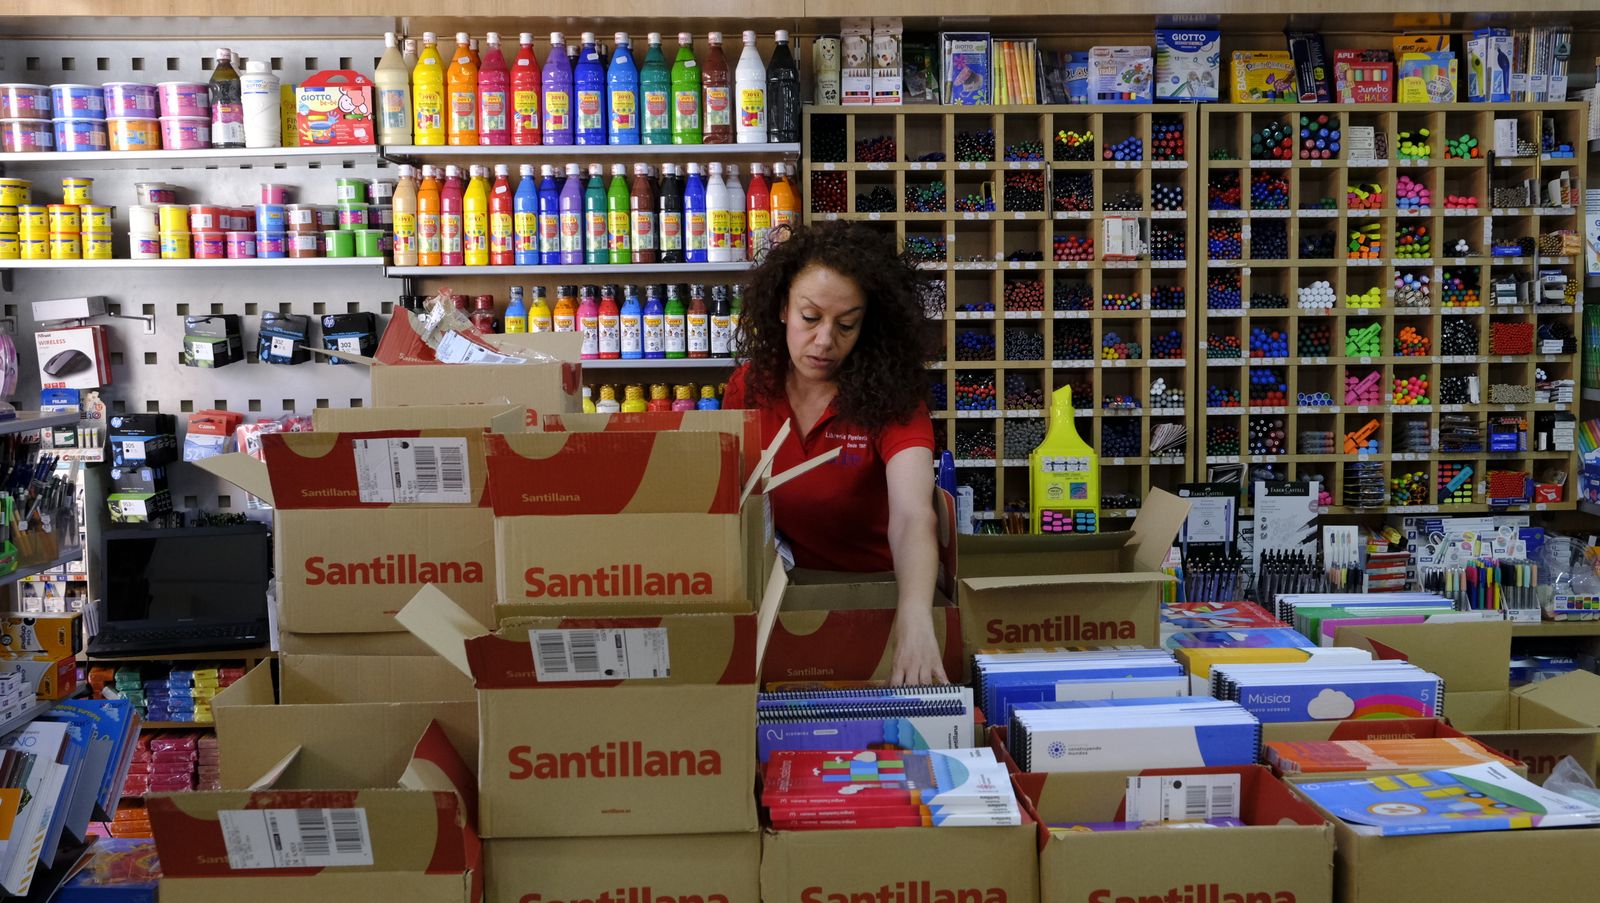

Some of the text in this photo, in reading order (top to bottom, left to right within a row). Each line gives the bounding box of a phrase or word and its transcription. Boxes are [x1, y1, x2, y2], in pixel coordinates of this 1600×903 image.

[1172, 33, 1206, 41] GIOTTO
[1358, 84, 1388, 92] Jumbo
[301, 488, 357, 497] Santillana
[522, 492, 580, 503] Santillana
[304, 554, 483, 585] Santillana
[525, 564, 712, 597] Santillana
[986, 614, 1136, 644] Santillana
[786, 666, 834, 678] Santillana
[1249, 692, 1291, 704] Música
[1420, 689, 1430, 700] 5
[510, 742, 721, 779] Santillana
